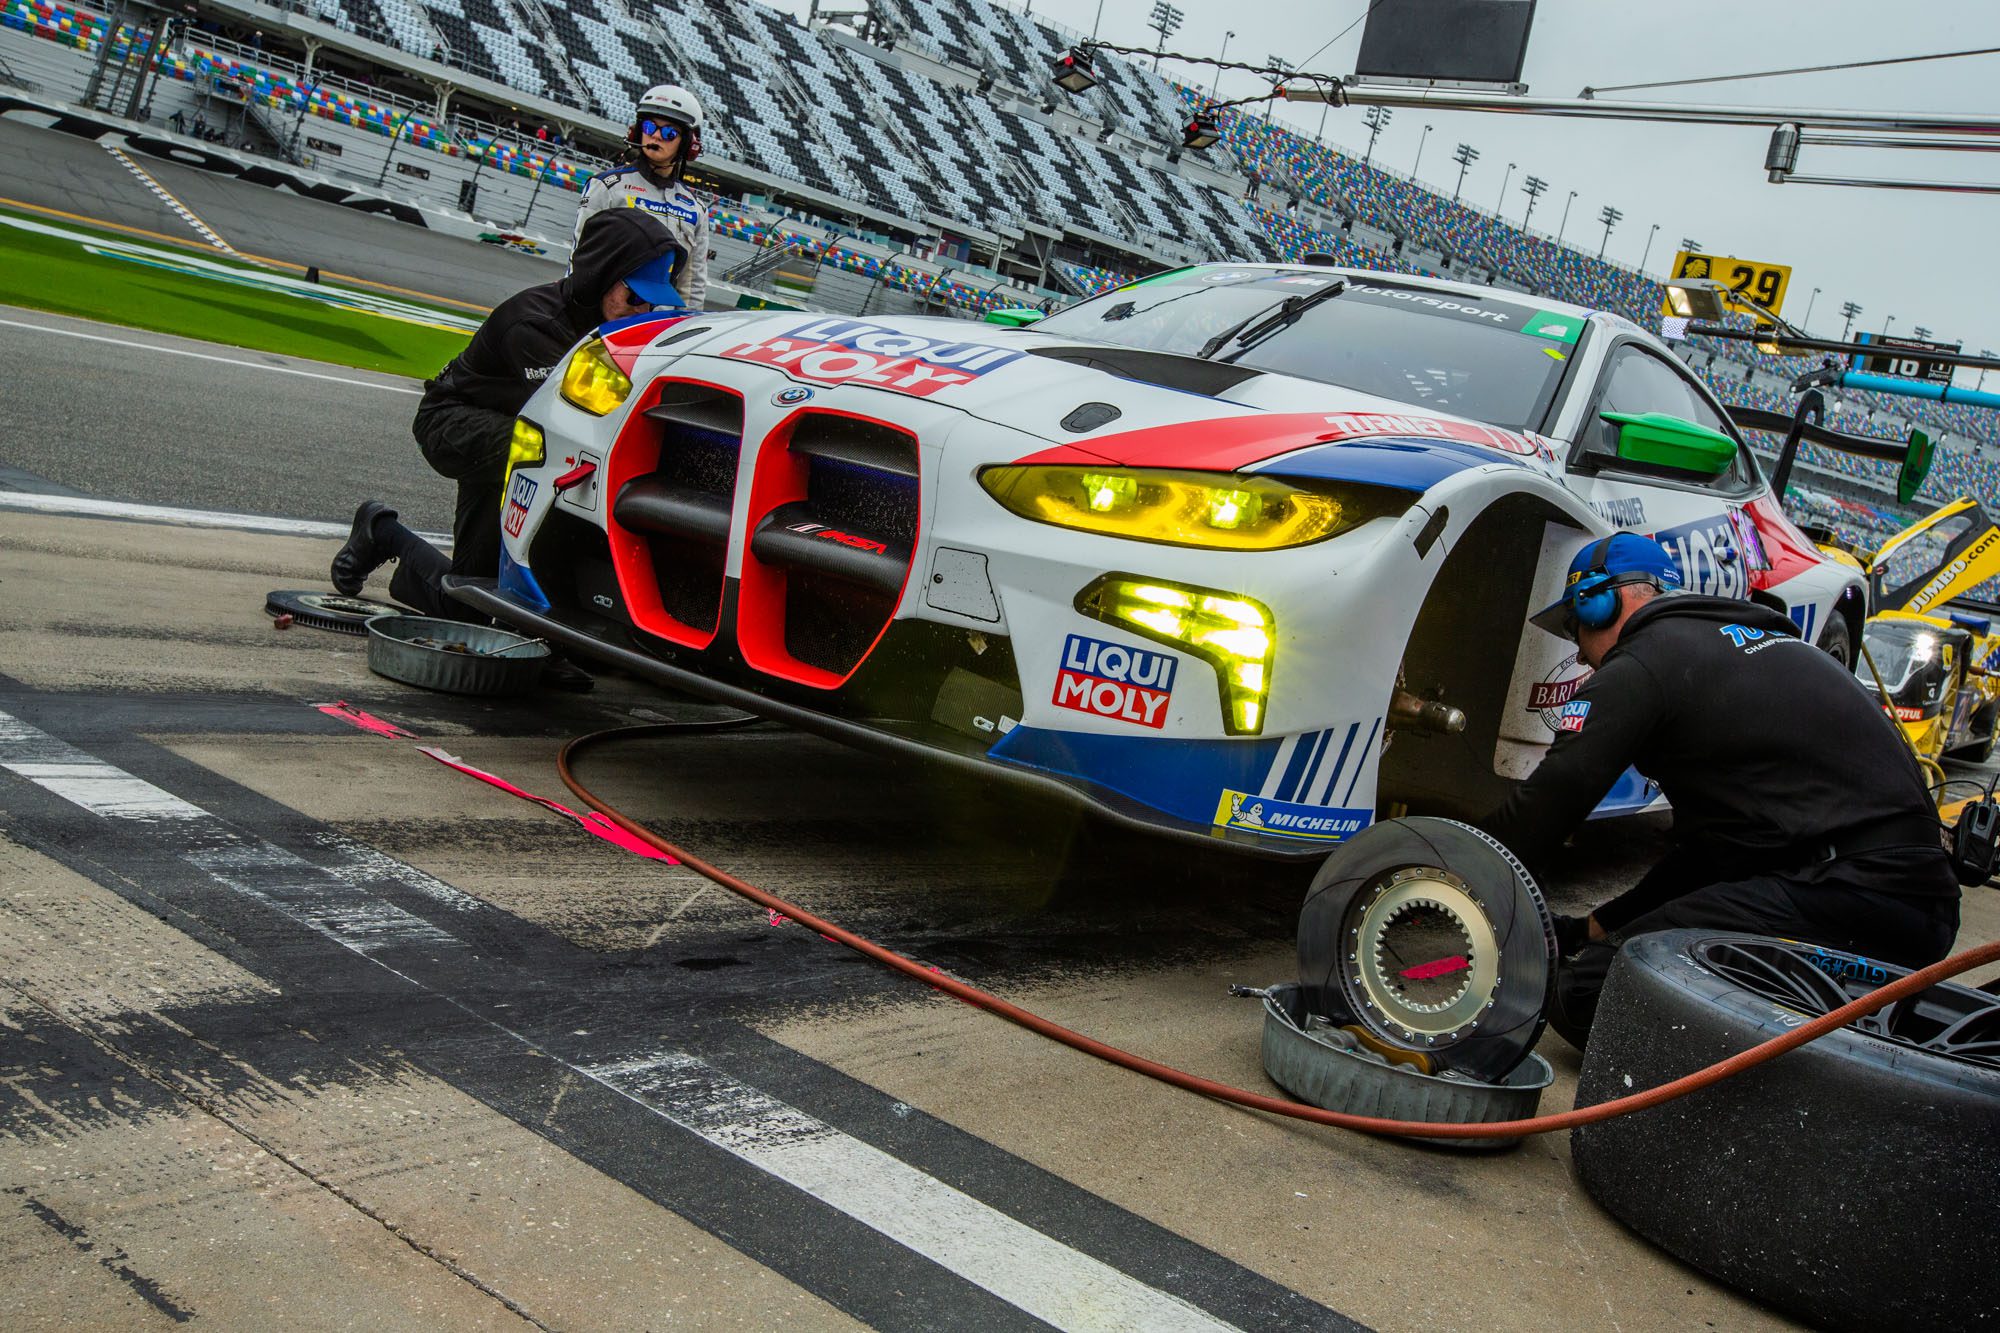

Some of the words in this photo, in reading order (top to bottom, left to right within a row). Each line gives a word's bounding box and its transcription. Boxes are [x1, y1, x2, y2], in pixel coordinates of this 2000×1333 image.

[649, 205, 692, 219] MICHELIN
[1343, 281, 1509, 323] Motorsport
[1726, 266, 1783, 308] 29
[793, 320, 1017, 370] LIQUI
[1885, 338, 1935, 350] PORSCHE
[735, 341, 970, 388] MOLY
[1324, 415, 1452, 438] TURNER
[513, 475, 537, 507] LIQUI
[506, 504, 527, 536] MOLY
[1608, 497, 1646, 528] TURNER
[816, 529, 888, 555] IMSA
[1910, 532, 1999, 613] JUMBO.com
[1066, 638, 1174, 689] LIQUI
[1058, 673, 1169, 724] MOLY
[1268, 813, 1361, 832] MICHELIN
